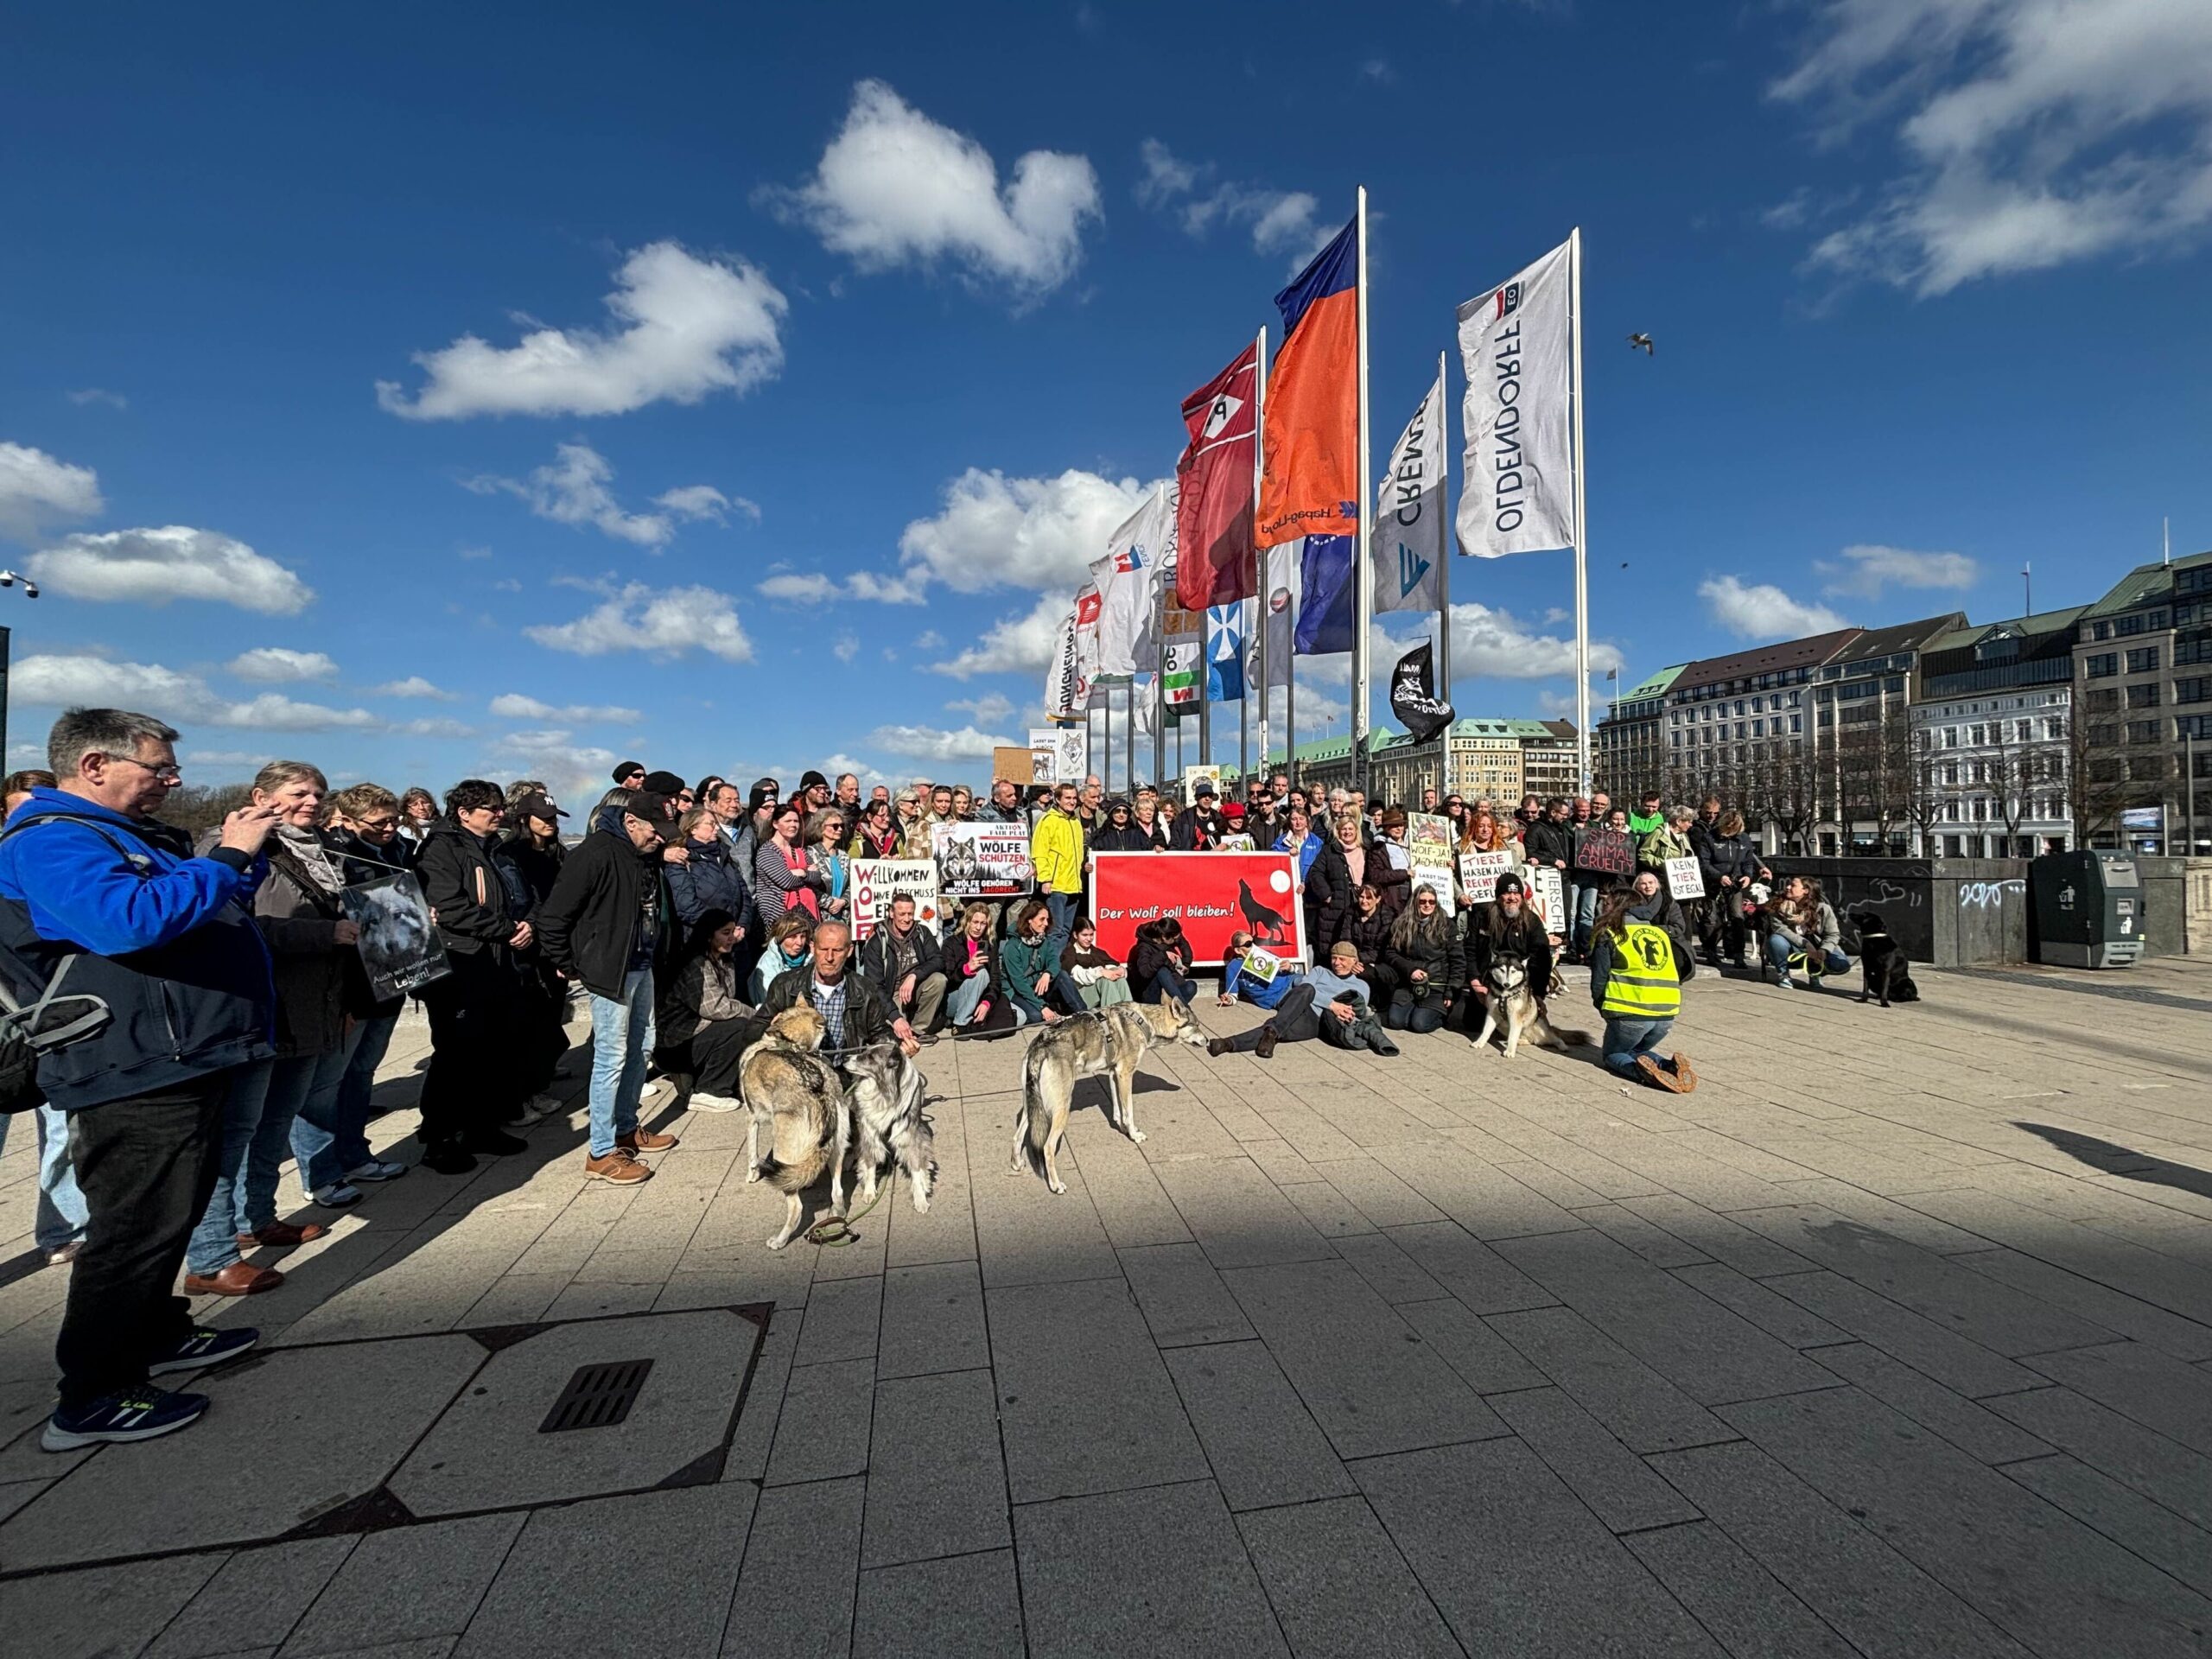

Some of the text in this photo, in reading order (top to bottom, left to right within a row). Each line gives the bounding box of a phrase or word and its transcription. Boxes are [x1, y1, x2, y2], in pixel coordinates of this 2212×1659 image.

[1589, 830, 1625, 844] STOP
[980, 841, 1020, 853] WÖLFE
[1581, 842, 1635, 861] ANIMAL
[979, 853, 1026, 862] SCHÜTZEN
[1462, 854, 1504, 867] TIERE
[1578, 855, 1635, 873] CRUELTY
[1672, 860, 1694, 870] KEIN
[1463, 867, 1492, 878] HABEN
[1672, 872, 1696, 882] TIER
[1673, 883, 1706, 895] IST EGAL
[1100, 902, 1234, 918] Der Wolf soll bleiben!
[373, 971, 393, 983] Auch
[406, 959, 429, 971] wollen
[429, 954, 442, 963] nur
[394, 967, 430, 989] Leben!
